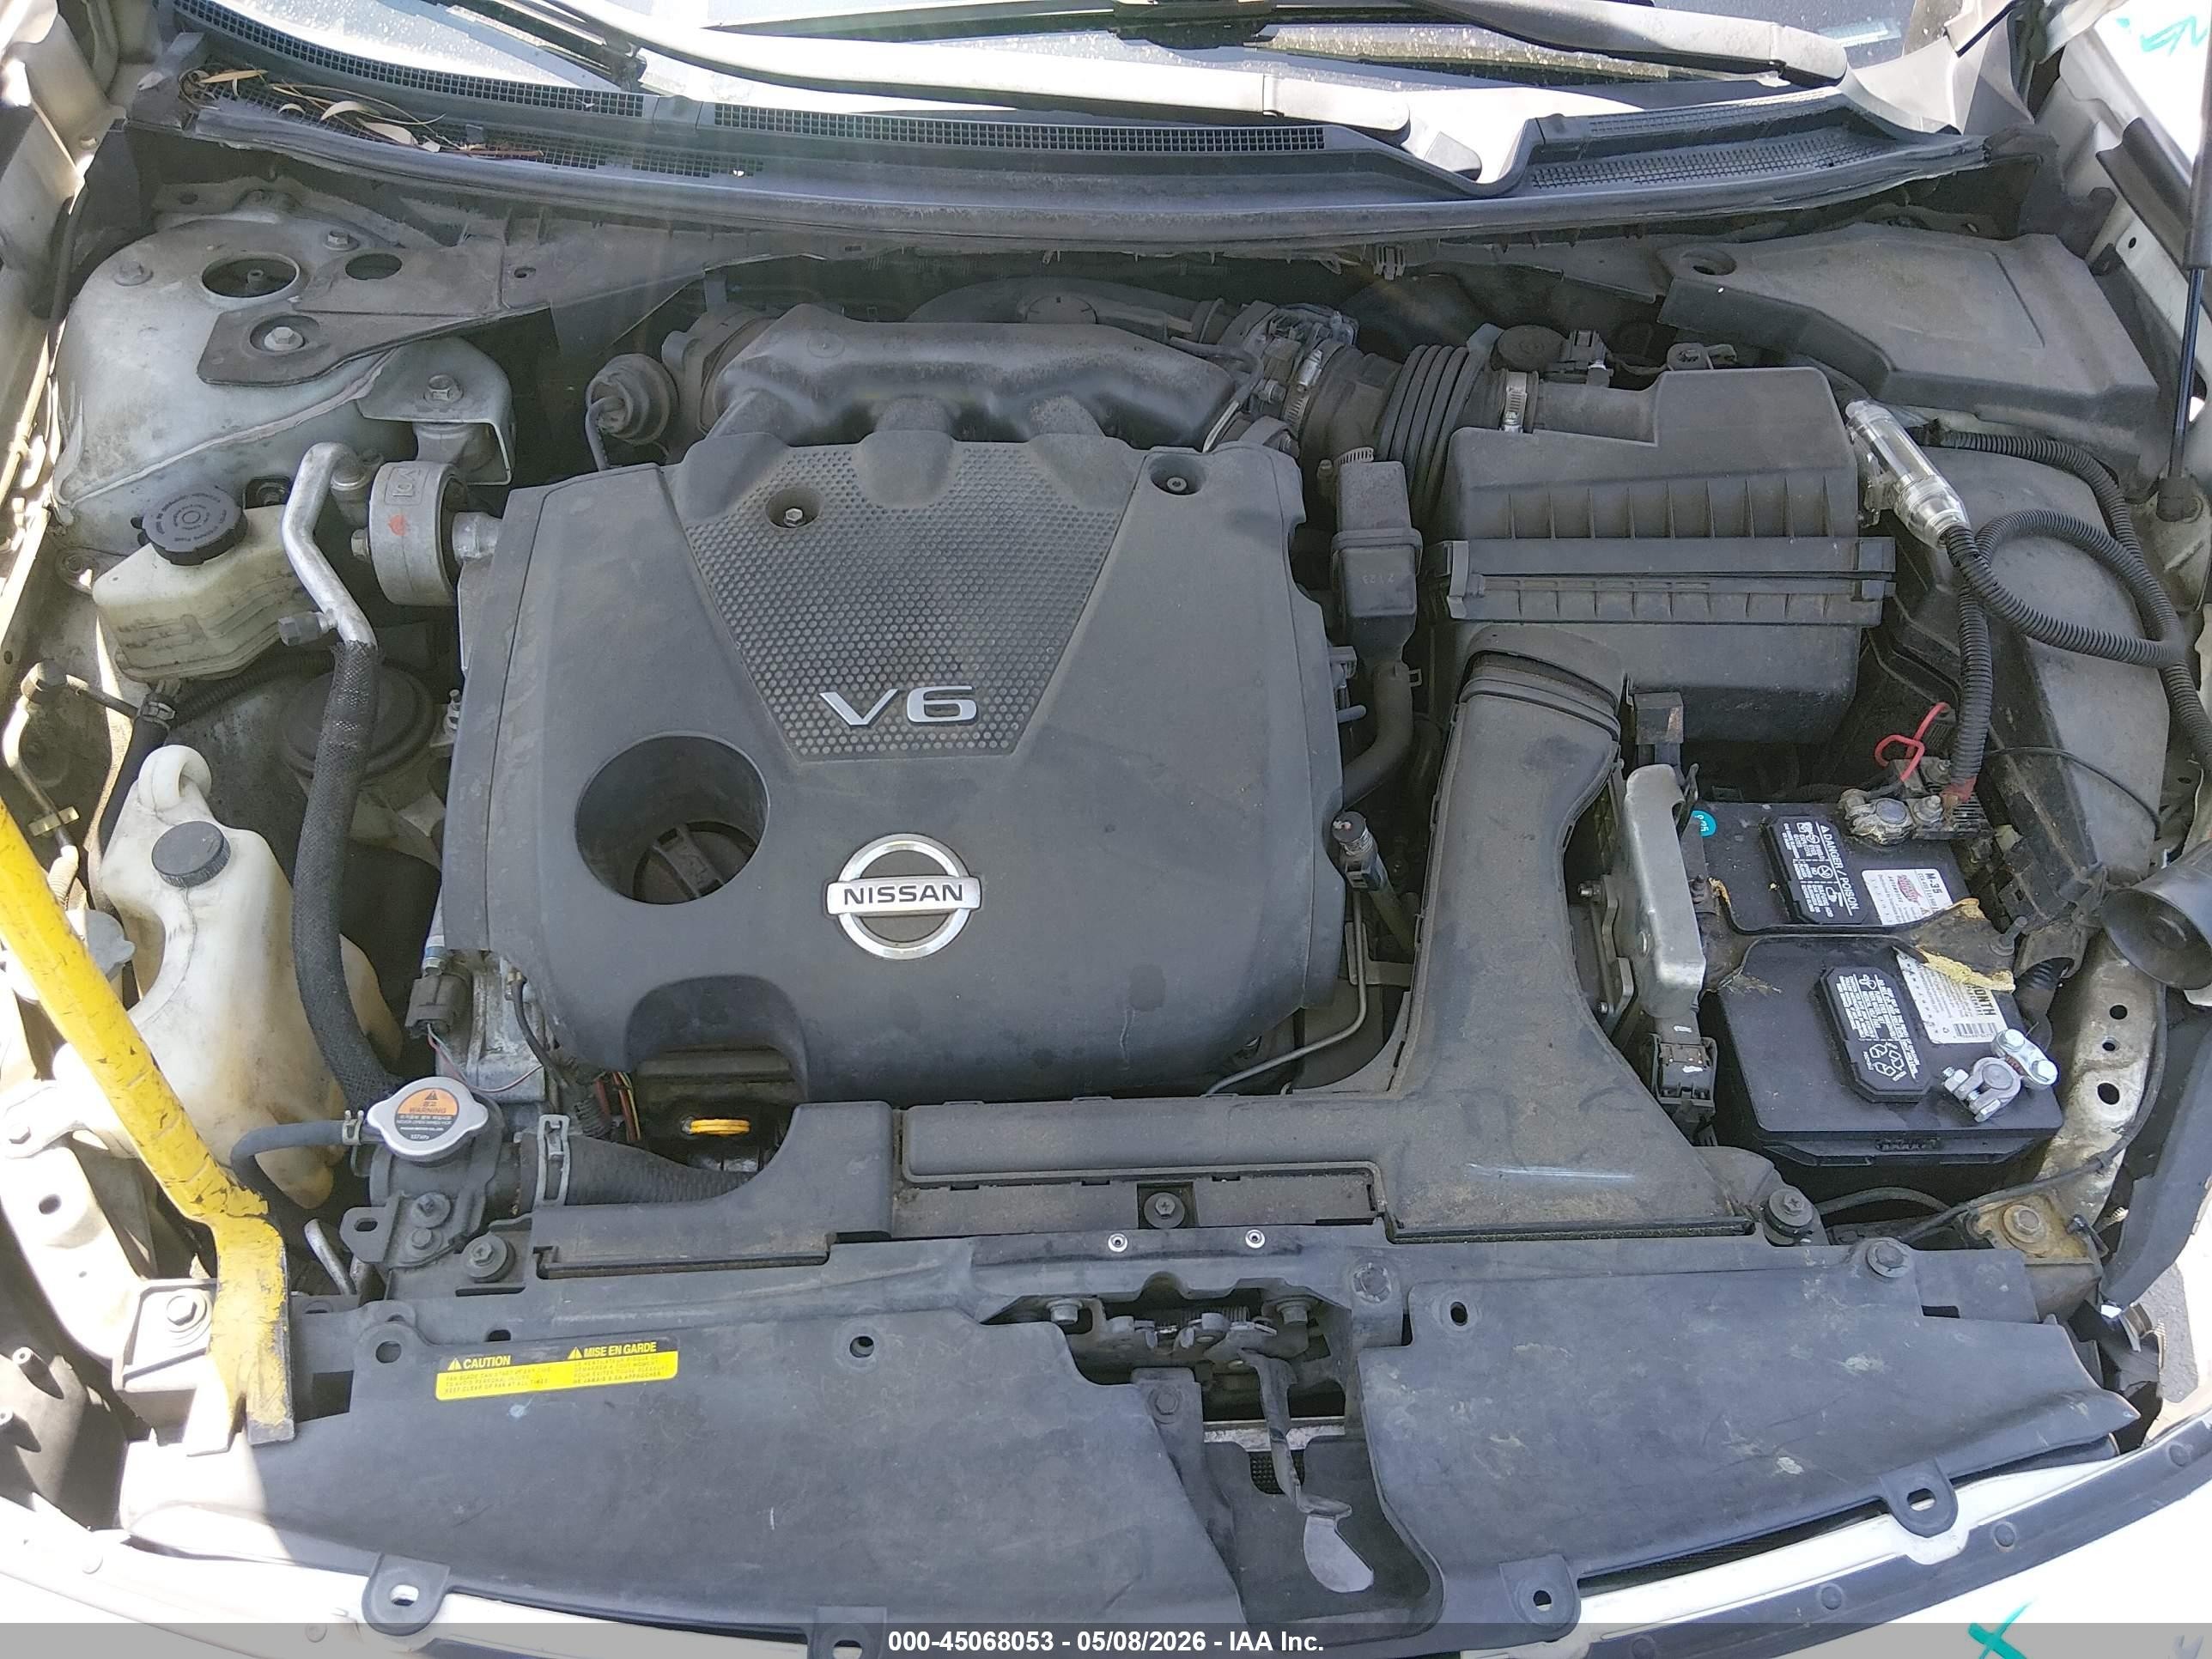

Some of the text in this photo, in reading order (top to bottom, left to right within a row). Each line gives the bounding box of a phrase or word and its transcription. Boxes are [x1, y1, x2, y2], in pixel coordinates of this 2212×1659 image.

[819, 685, 977, 726] V6
[1823, 834, 1844, 869] DANGER
[1839, 878, 1860, 909] POISON
[844, 884, 963, 904] NISSAN
[584, 1342, 657, 1357] MISE EN GARDE
[463, 1355, 511, 1369] CAUTION
